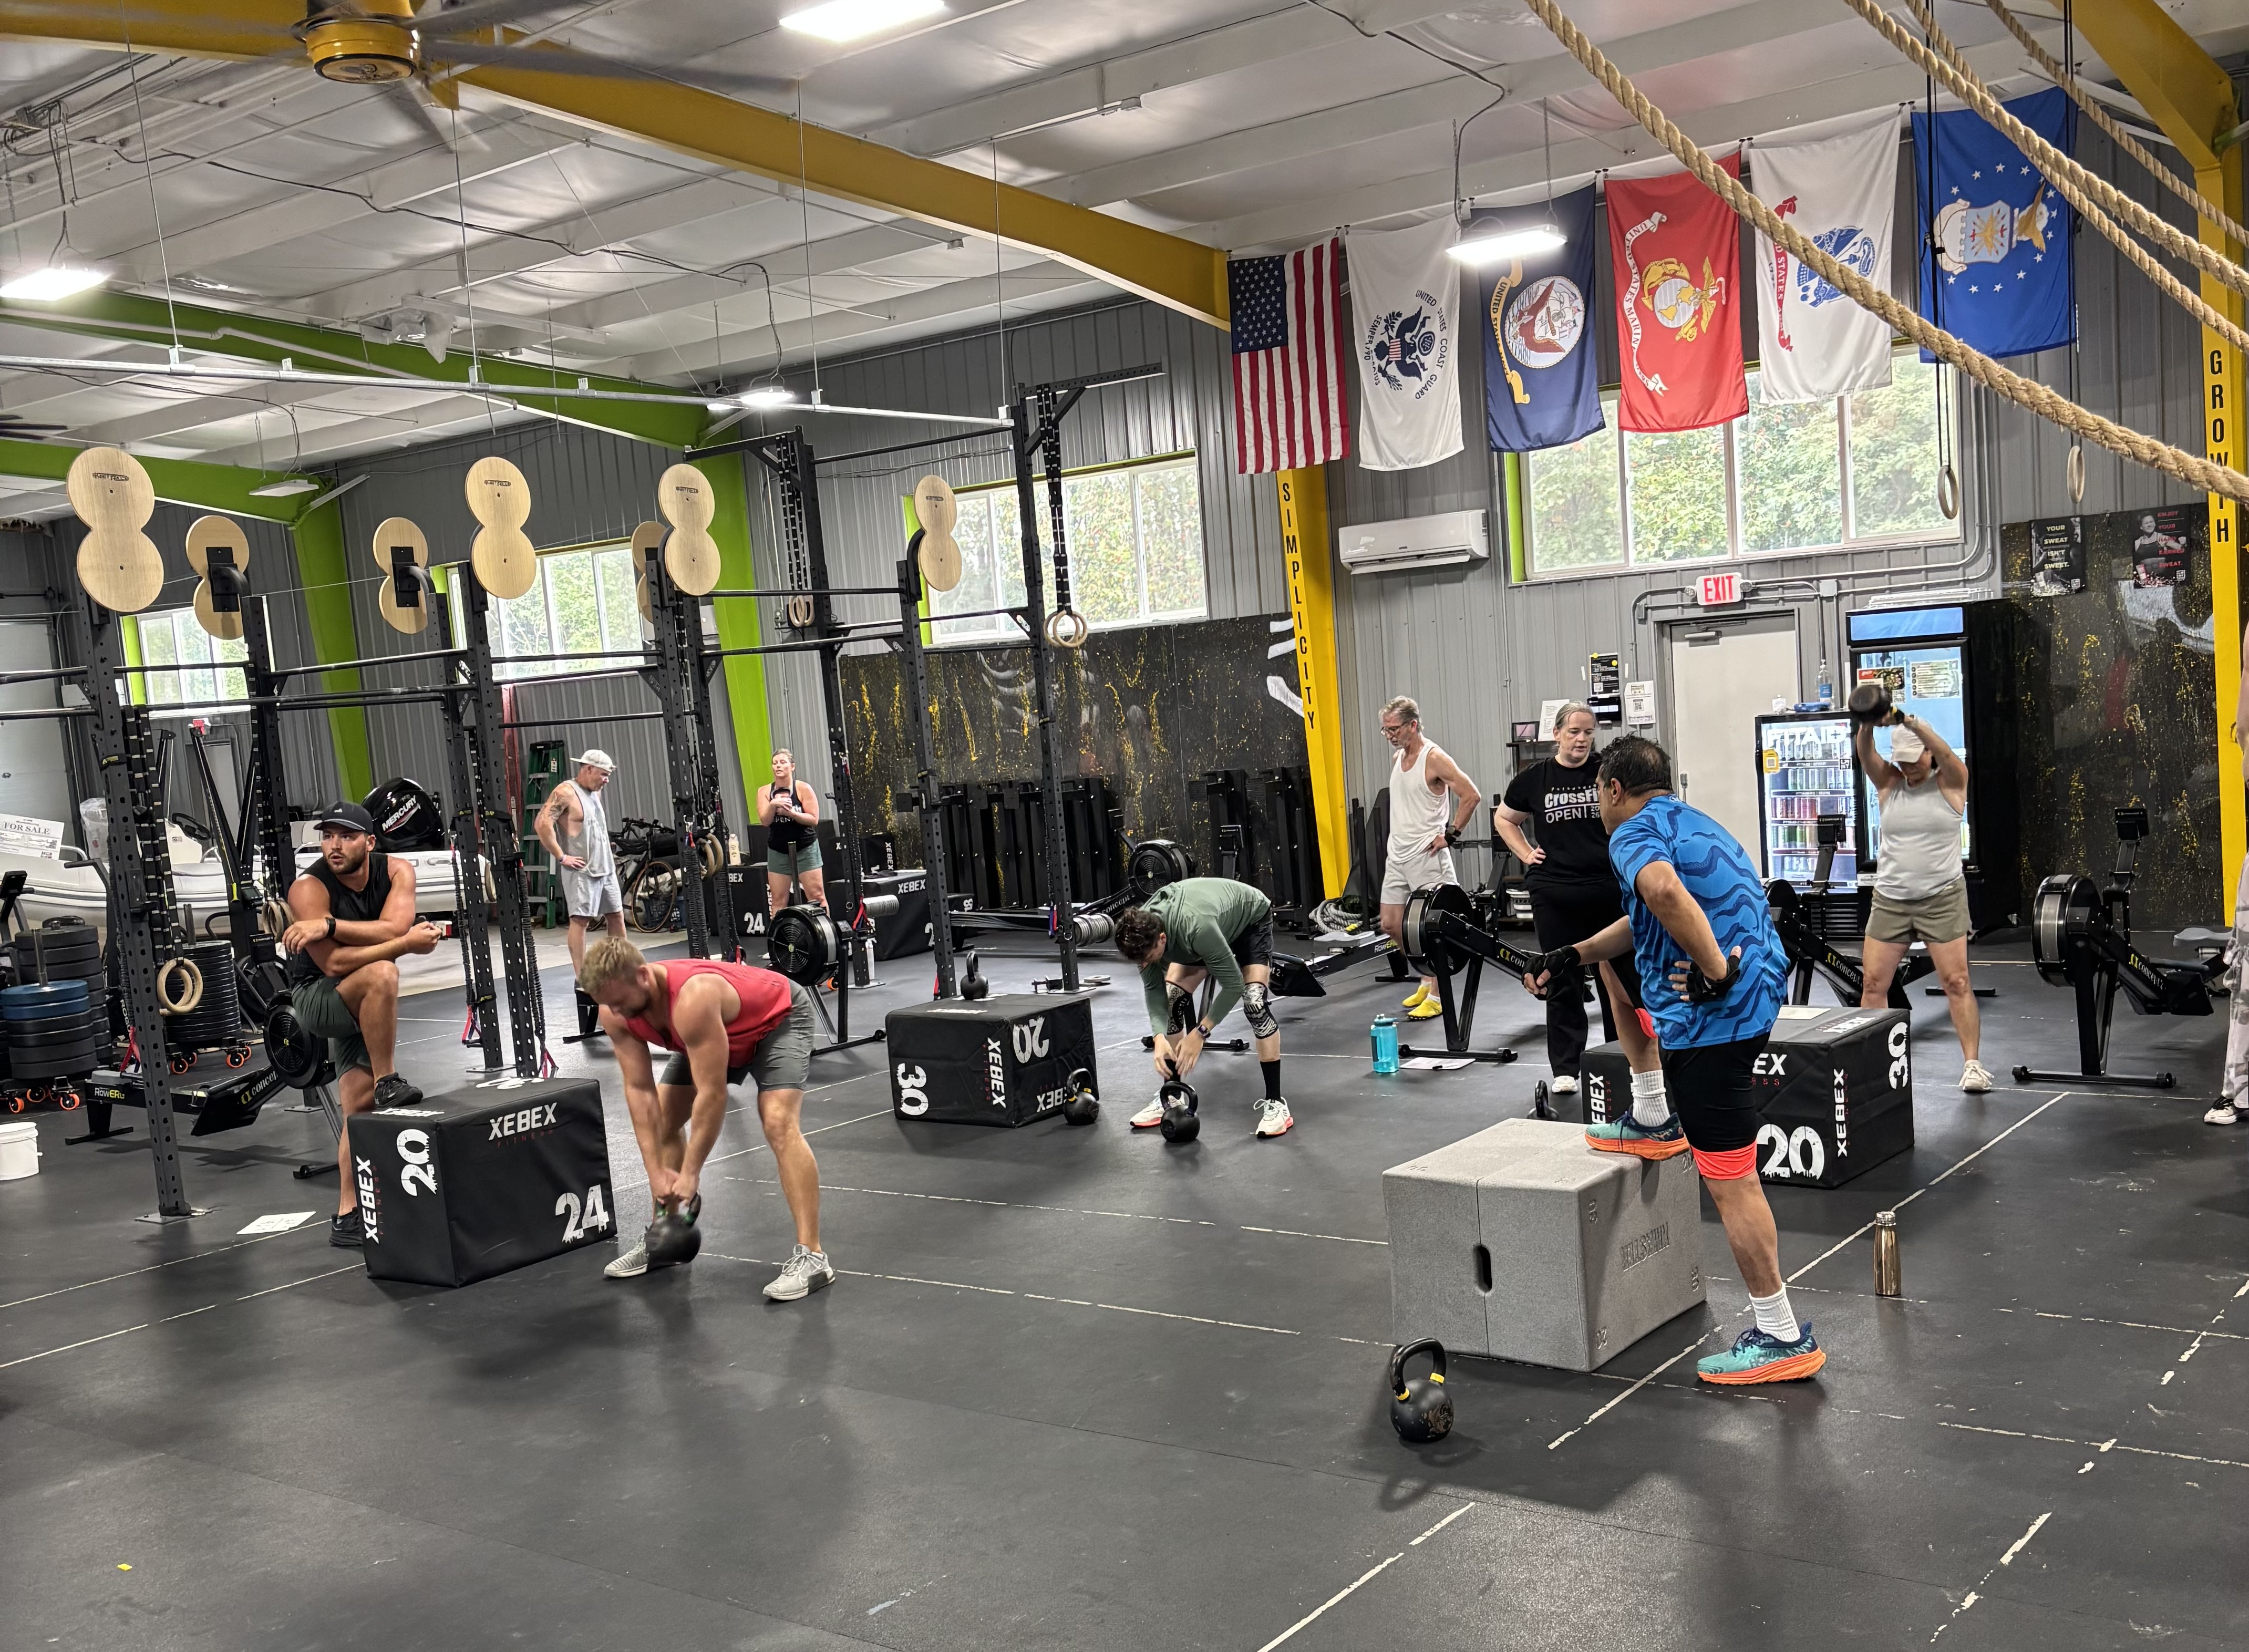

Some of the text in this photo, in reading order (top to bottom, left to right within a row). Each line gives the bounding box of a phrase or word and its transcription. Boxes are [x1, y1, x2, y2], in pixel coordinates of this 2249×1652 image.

[1492, 282, 1508, 314] UNITED
[1625, 263, 1639, 303] STATES
[1367, 315, 1382, 345] SEMPER
[1415, 290, 1448, 400] UNITED STATES COAST GUARD
[1626, 306, 1641, 350] MARIN
[1283, 482, 1315, 729] SIMPLICITY
[1704, 575, 1734, 603] EXIT
[1767, 725, 1847, 748] FITAID
[381, 794, 417, 831] MERCURY
[1544, 788, 1598, 808] CrossFi
[1546, 807, 1582, 823] OPEN
[4, 822, 23, 831] FOR
[25, 825, 51, 835] SALE
[885, 842, 894, 871] XEBEX
[729, 873, 744, 883] BEX
[897, 879, 926, 894] XEBEX
[744, 912, 766, 935] 24
[120, 999, 131, 1033] ROGU
[1012, 1015, 1050, 1064] 20
[1887, 1021, 1909, 1090] 30
[896, 1062, 930, 1116] 30
[987, 1037, 1006, 1109] XEBEX
[1588, 1072, 1606, 1124] EBEX
[1833, 1068, 1848, 1158] XEBEX
[488, 1102, 558, 1141] XEBEX
[497, 1129, 554, 1149] FITNESS
[396, 1129, 438, 1196] 20
[1756, 1123, 1825, 1180] 20
[356, 1154, 379, 1244] XEBEX
[555, 1184, 610, 1244] 24
